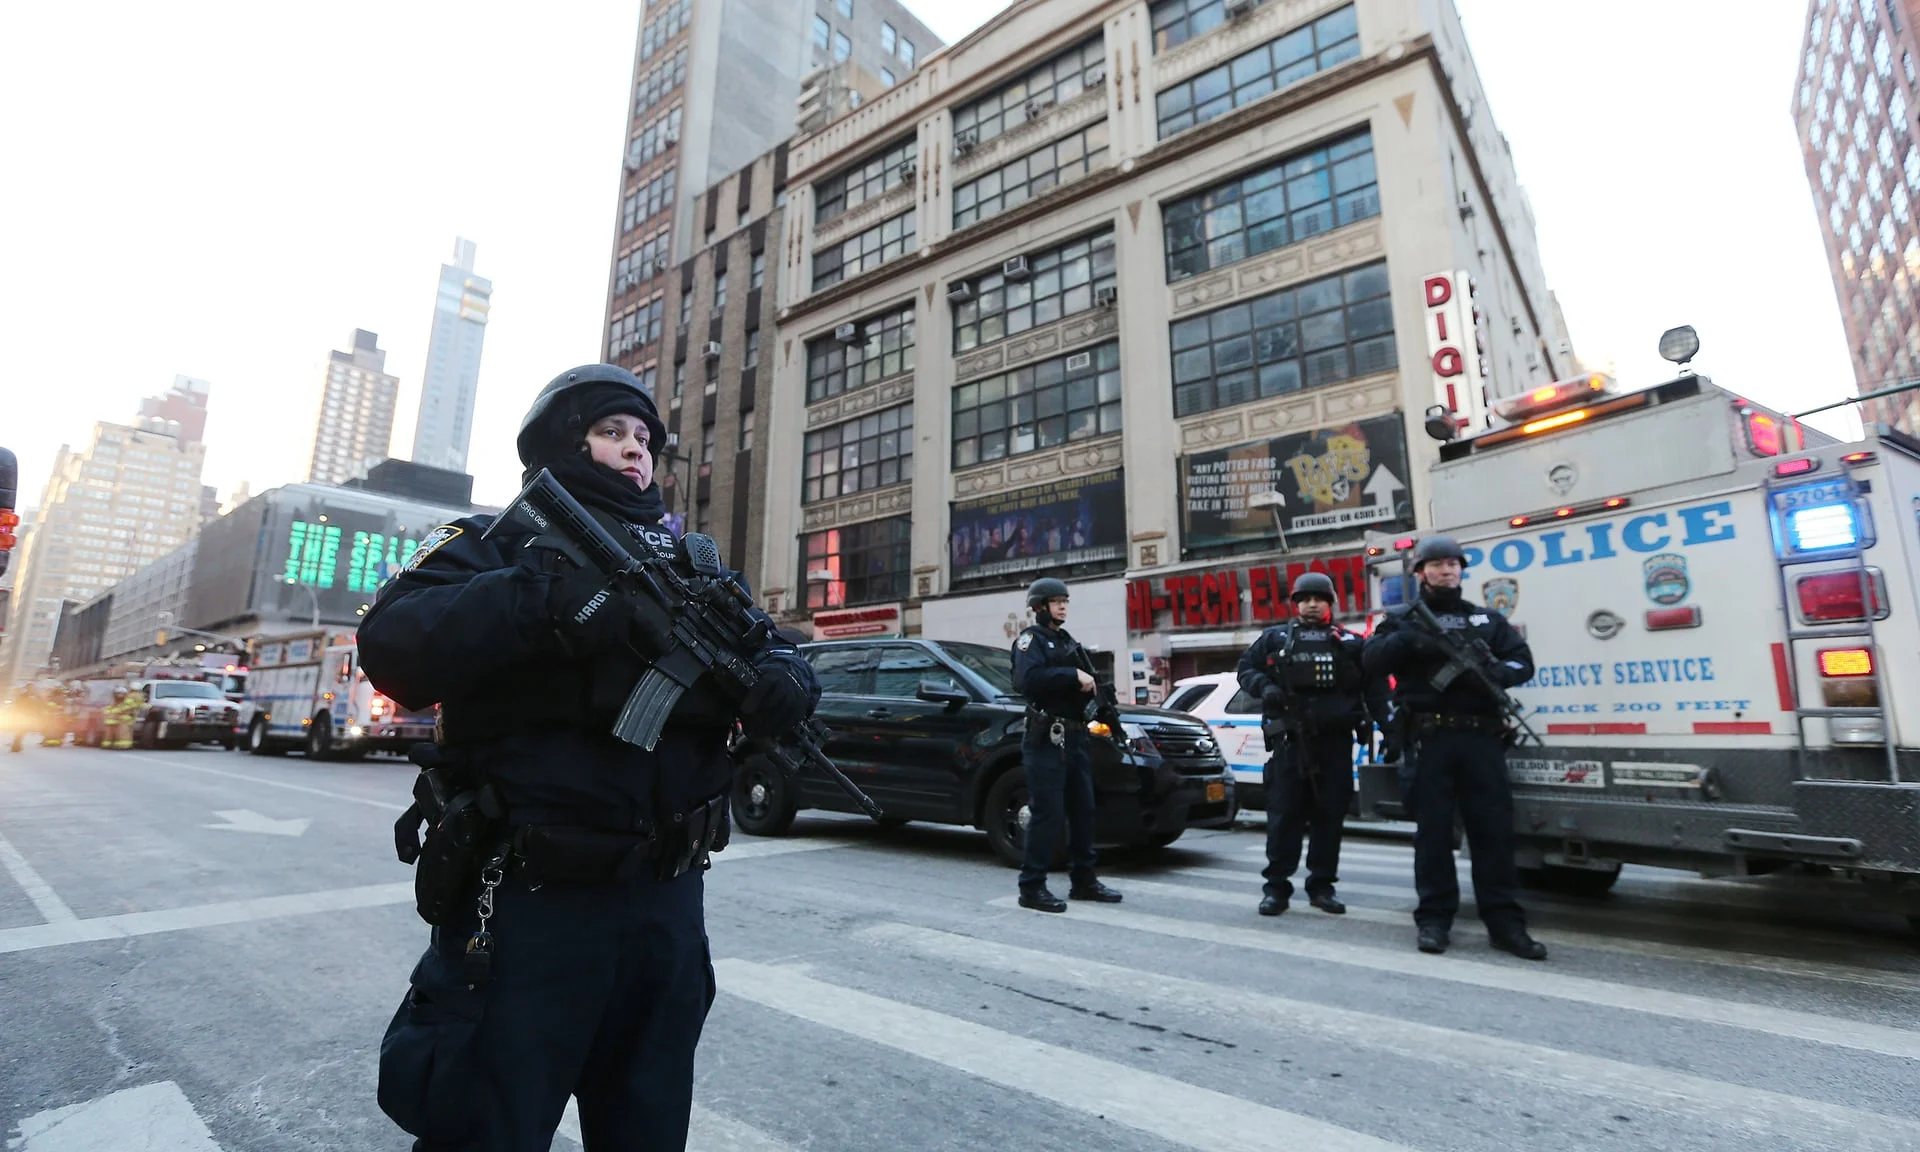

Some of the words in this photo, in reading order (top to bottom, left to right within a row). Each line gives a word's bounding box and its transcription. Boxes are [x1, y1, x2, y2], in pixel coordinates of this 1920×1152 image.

[1212, 458, 1250, 473] POTTER
[1251, 456, 1277, 470] FANS
[1186, 474, 1220, 485] VISITING
[1220, 473, 1238, 484] NEW
[1239, 472, 1261, 482] YORK
[1261, 470, 1283, 480] CITY
[1189, 484, 1247, 499] ABSOLUTELY
[520, 501, 536, 518] SRG
[534, 515, 547, 528] 058
[1187, 499, 1210, 512] TAKE
[1211, 498, 1222, 511] IN
[1224, 497, 1247, 510] THIS
[1295, 514, 1338, 529] ENTRANCE
[1339, 512, 1352, 522] ON
[1378, 507, 1390, 517] ST
[637, 530, 674, 549] ICE
[1460, 501, 1736, 580] POLICE
[1125, 570, 1240, 630] HI-TECH
[1249, 555, 1366, 620] ELET
[574, 589, 610, 624] HARDY
[1525, 664, 1602, 688] GENCY
[1614, 657, 1715, 685] SERVICE
[1535, 703, 1599, 714] BACK
[1613, 701, 1662, 713] 200
[1676, 699, 1752, 712] FEET
